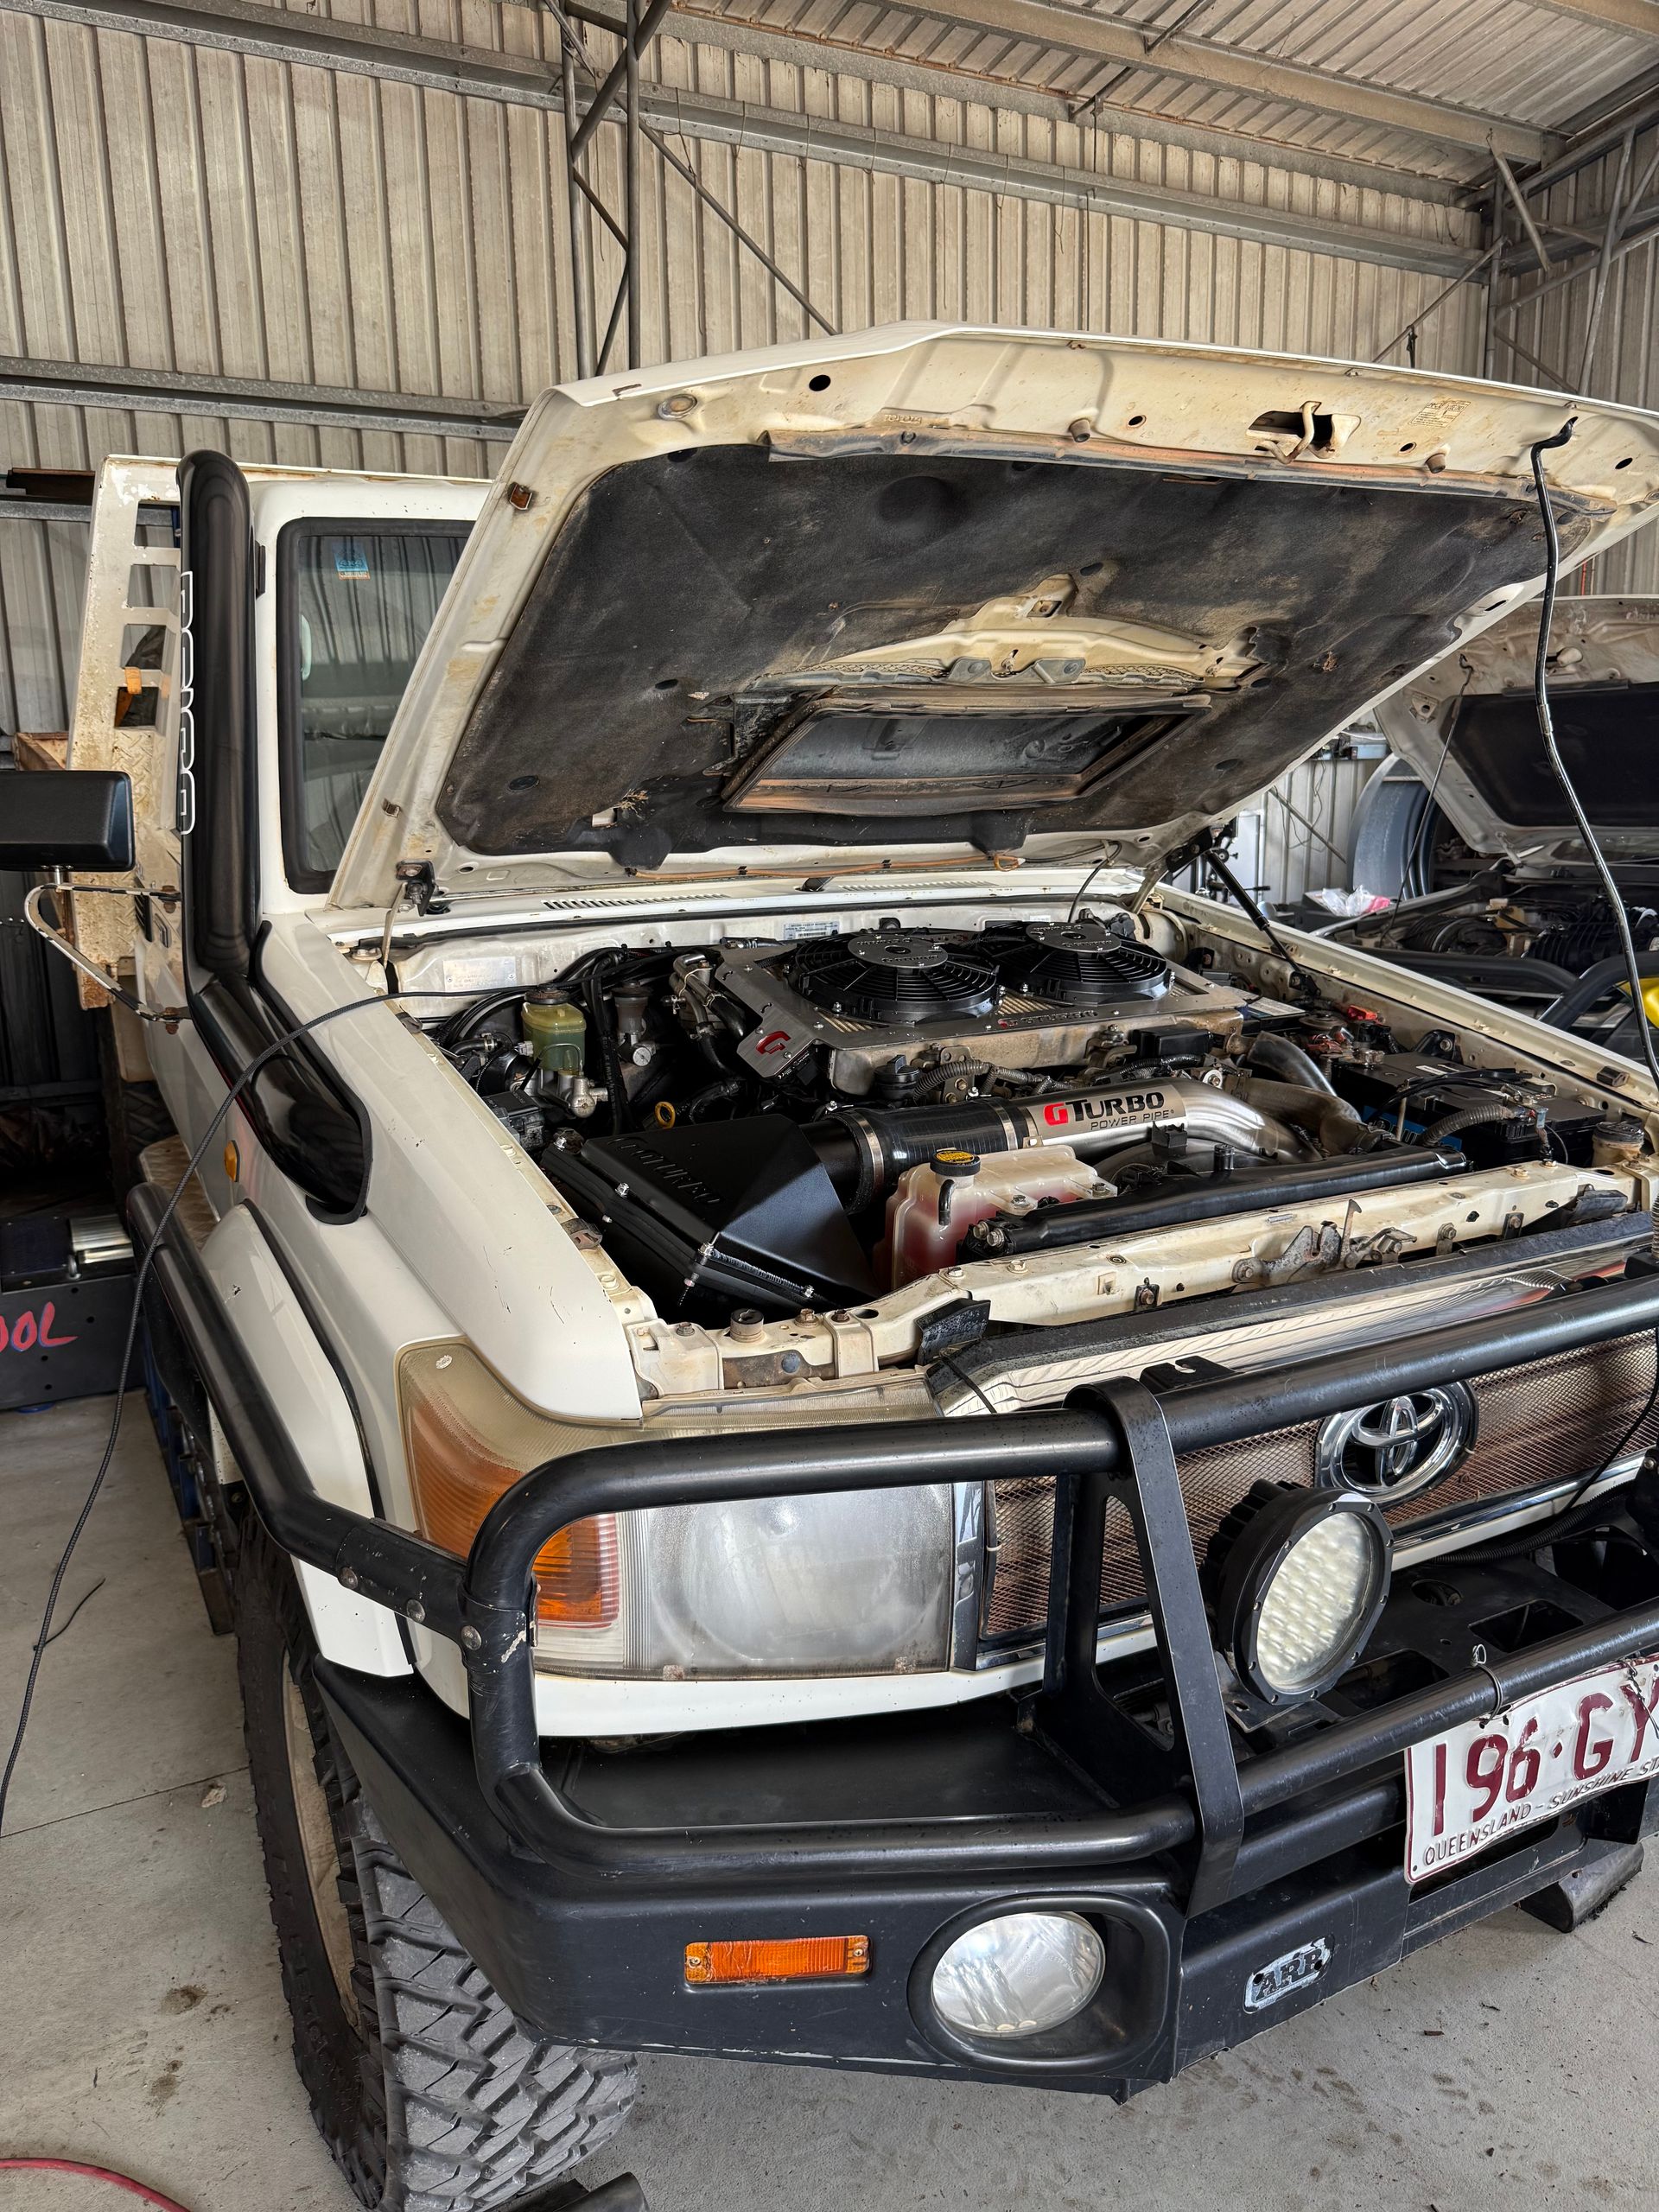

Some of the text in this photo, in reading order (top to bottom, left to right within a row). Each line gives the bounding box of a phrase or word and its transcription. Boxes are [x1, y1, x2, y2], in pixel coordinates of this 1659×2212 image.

[1090, 1116, 1137, 1131] POWER
[1424, 1802, 1533, 1866] QUEENSLAND
[1548, 1767, 1635, 1810] SUNSHINE
